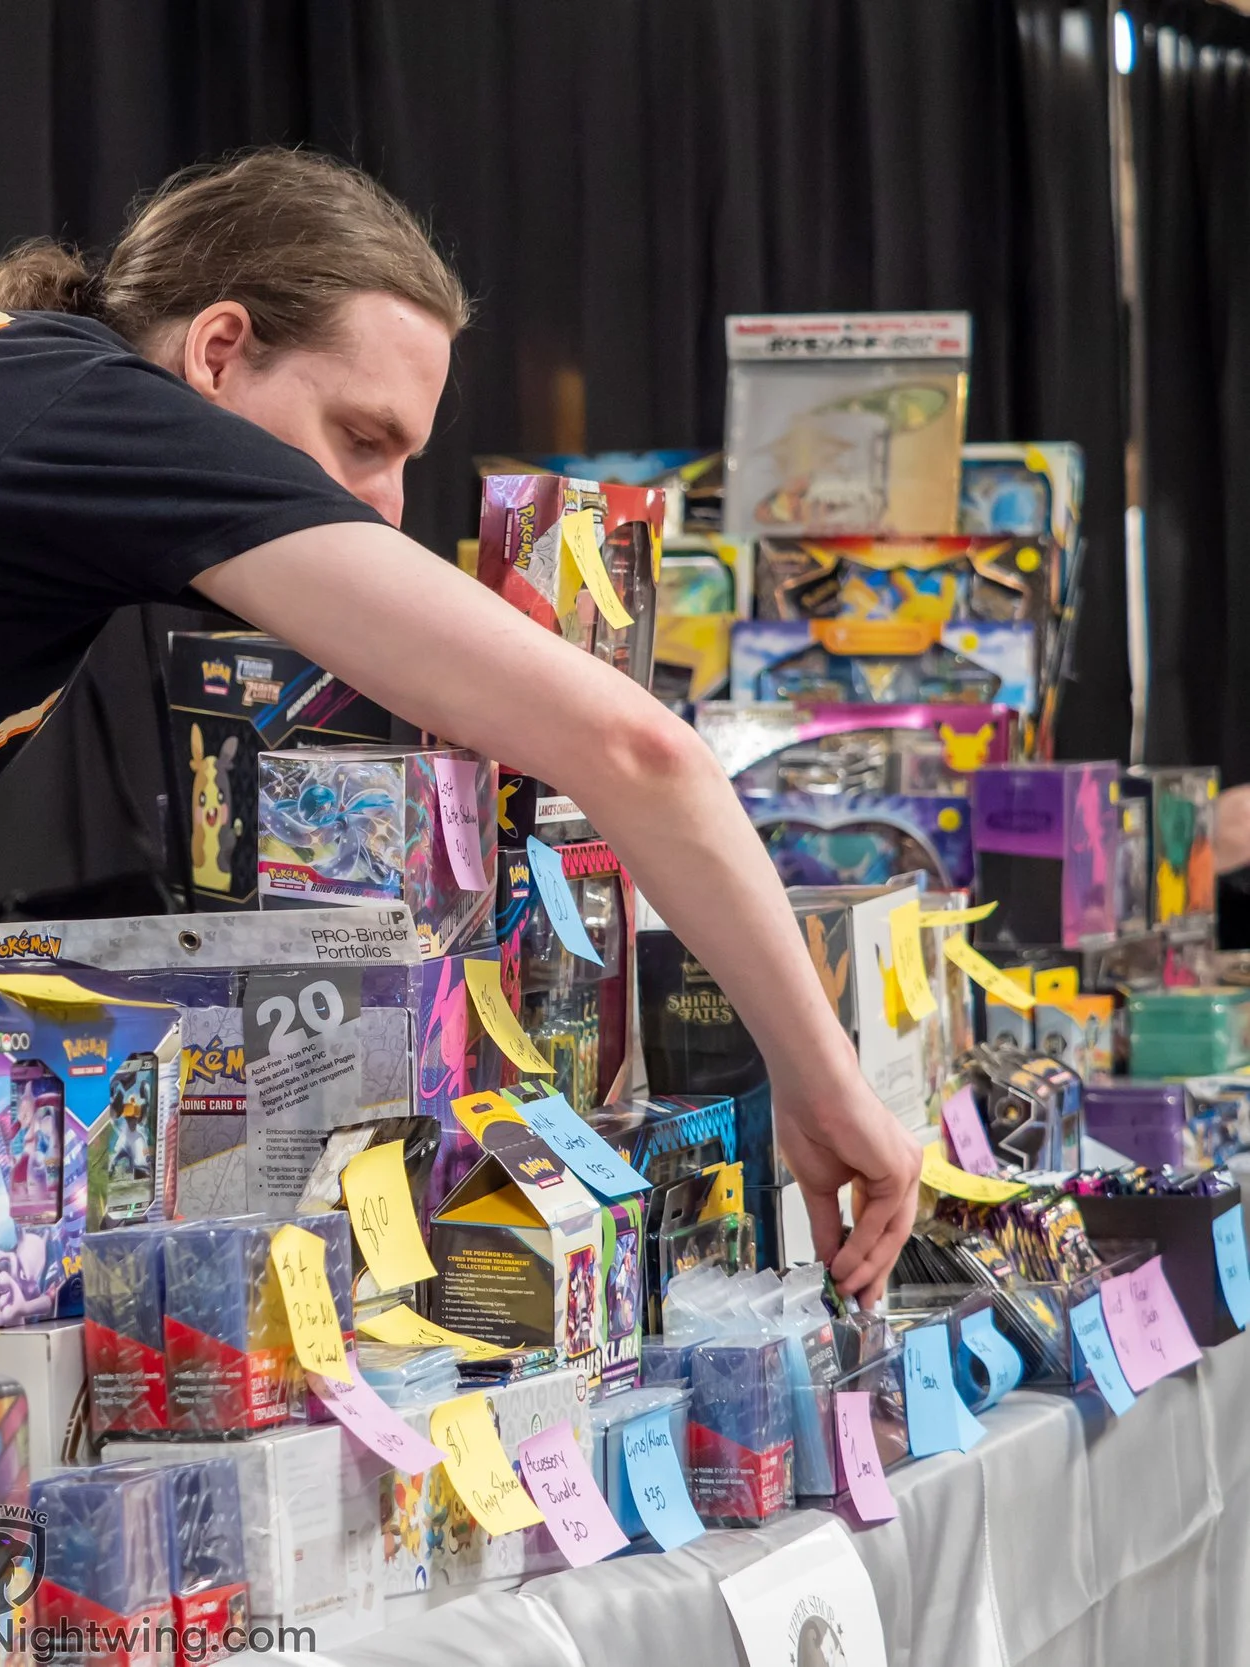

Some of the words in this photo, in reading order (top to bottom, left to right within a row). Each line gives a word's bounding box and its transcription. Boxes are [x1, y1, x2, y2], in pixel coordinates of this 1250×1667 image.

[311, 927, 409, 945] PRO-Binder
[315, 945, 393, 960] Portfolios
[255, 979, 345, 1052] 20
[667, 993, 729, 1013] SHININ
[677, 1007, 734, 1024] FATES
[287, 1050, 302, 1061] Non
[301, 1043, 317, 1055] PVC
[254, 1074, 272, 1087] Sans
[271, 1066, 290, 1080] acide
[294, 1058, 311, 1071] Sans
[311, 1050, 327, 1063] PVC
[258, 1082, 285, 1098] Archival
[284, 1075, 301, 1087] Safe
[300, 1061, 334, 1080] 18-Pocket
[333, 1052, 356, 1067] Pages
[261, 1095, 283, 1108] Pages
[283, 1089, 293, 1099] A4
[293, 1084, 309, 1096] pour
[309, 1080, 319, 1088] un
[318, 1064, 356, 1085] rangement
[209, 1098, 234, 1111] CARD
[276, 1104, 285, 1113] et
[284, 1094, 311, 1110] durable
[360, 1194, 389, 1257] $10
[602, 1333, 639, 1368] KLARA
[445, 1420, 470, 1468] $1
[524, 1450, 568, 1475] Accessory
[542, 1480, 581, 1505] Bundle
[644, 1485, 667, 1511] $35
[562, 1519, 589, 1542] $20
